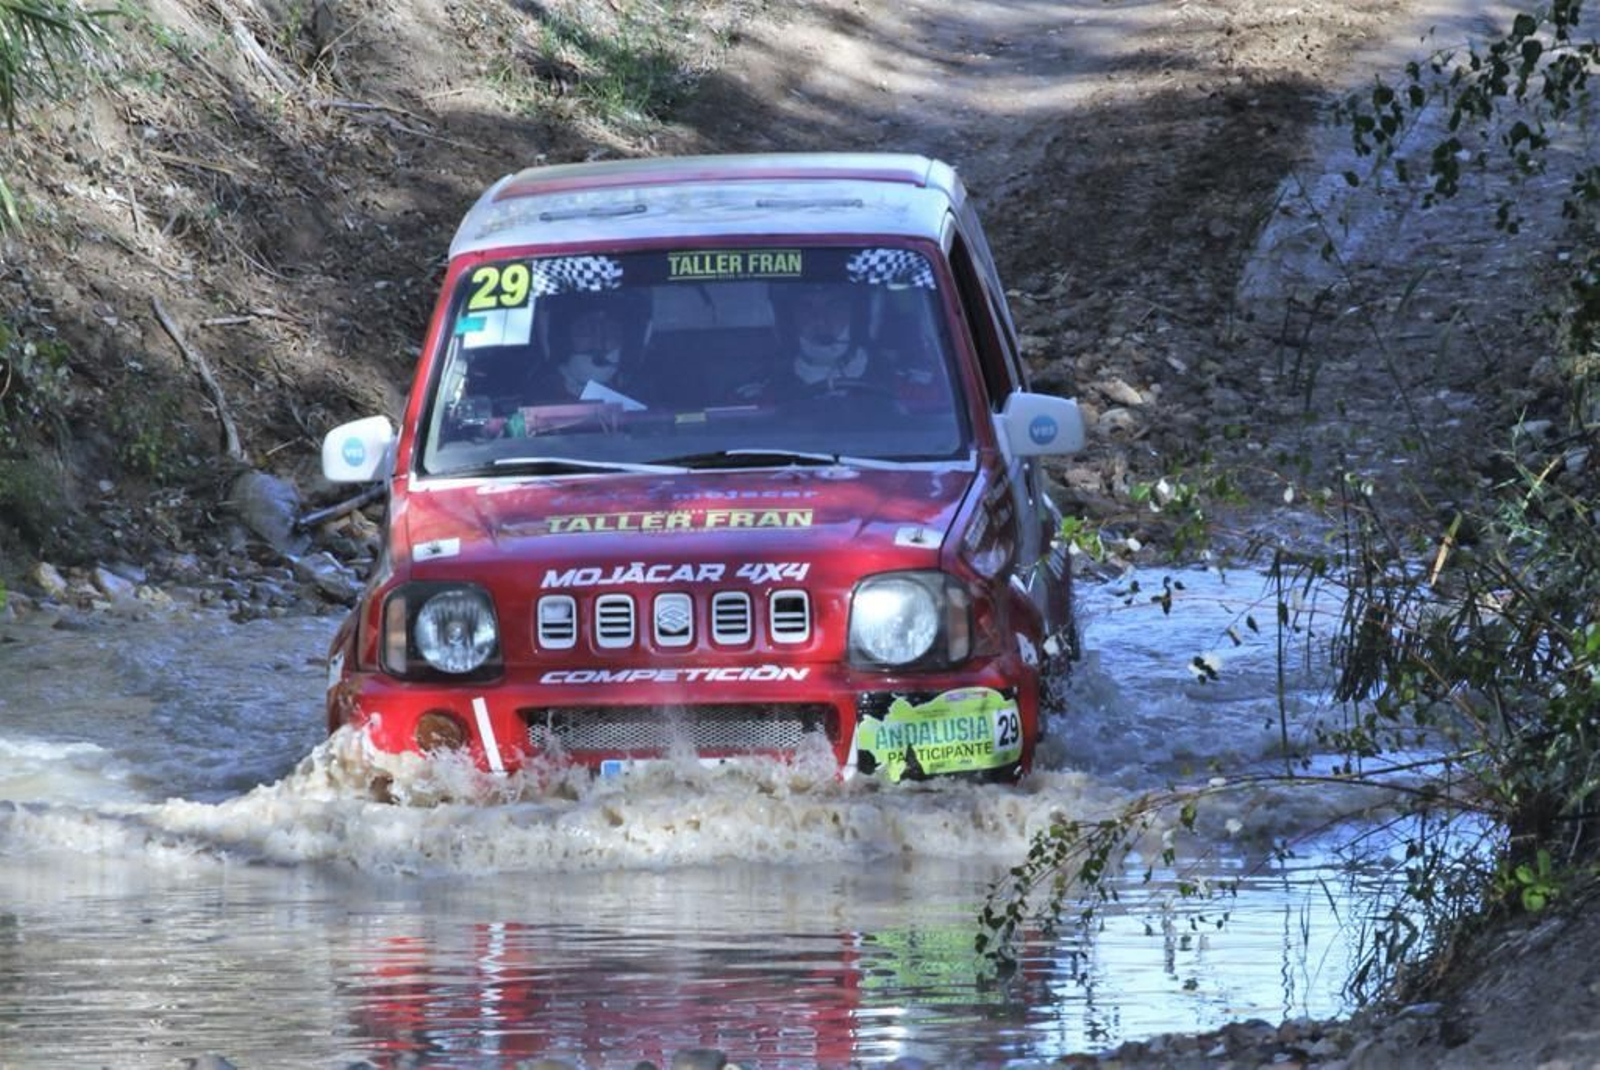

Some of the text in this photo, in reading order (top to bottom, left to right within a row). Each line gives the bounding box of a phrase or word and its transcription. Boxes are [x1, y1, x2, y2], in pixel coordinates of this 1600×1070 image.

[667, 253, 802, 275] TALLER FRAN
[468, 263, 530, 310] 29
[547, 510, 813, 533] TALLER FRAN
[875, 715, 989, 750] ANDALUSIA
[997, 713, 1019, 747] 29
[888, 740, 993, 763] PATICIPANTE
